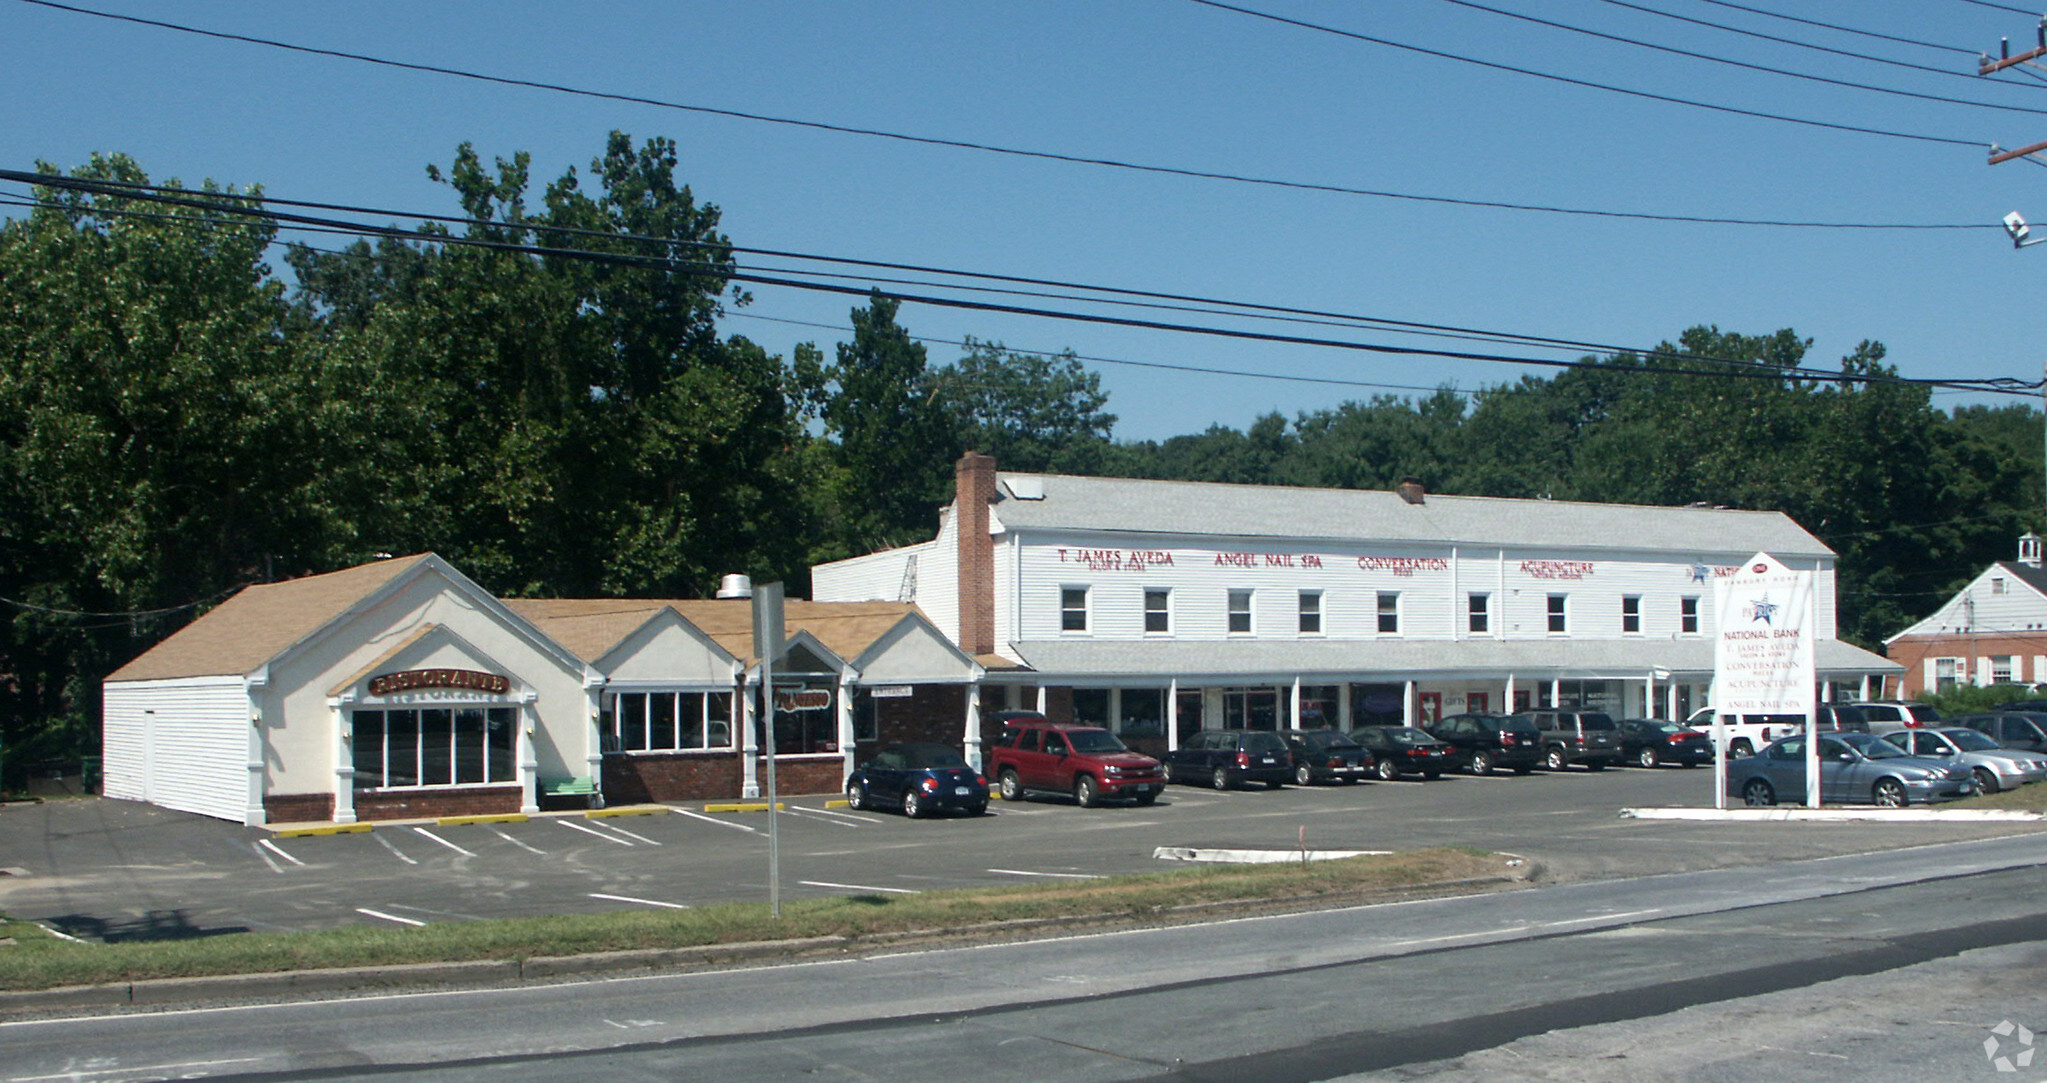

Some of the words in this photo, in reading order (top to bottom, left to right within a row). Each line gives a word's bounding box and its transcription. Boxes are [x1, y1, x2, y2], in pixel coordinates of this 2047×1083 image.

[1075, 549, 1121, 563] JAMES
[1129, 551, 1174, 567] AVEDA
[1214, 553, 1258, 567] ANGEL
[1265, 553, 1294, 567] NAIL
[1301, 554, 1323, 569] SPA
[1358, 556, 1448, 570] CONVERSATION
[1520, 560, 1594, 574] ACUPUNCTURE
[1724, 630, 1769, 640] NATIONAL
[1773, 628, 1800, 639] BANK
[1737, 644, 1765, 652] JAMES
[1770, 643, 1799, 651] AVEDA
[1726, 661, 1799, 670] CONVERSATION
[375, 671, 503, 692] RISTORANTE
[1728, 680, 1798, 688] ACUPUNCTURE
[1728, 701, 1755, 709] ANGEL
[1760, 701, 1780, 709] NAIL
